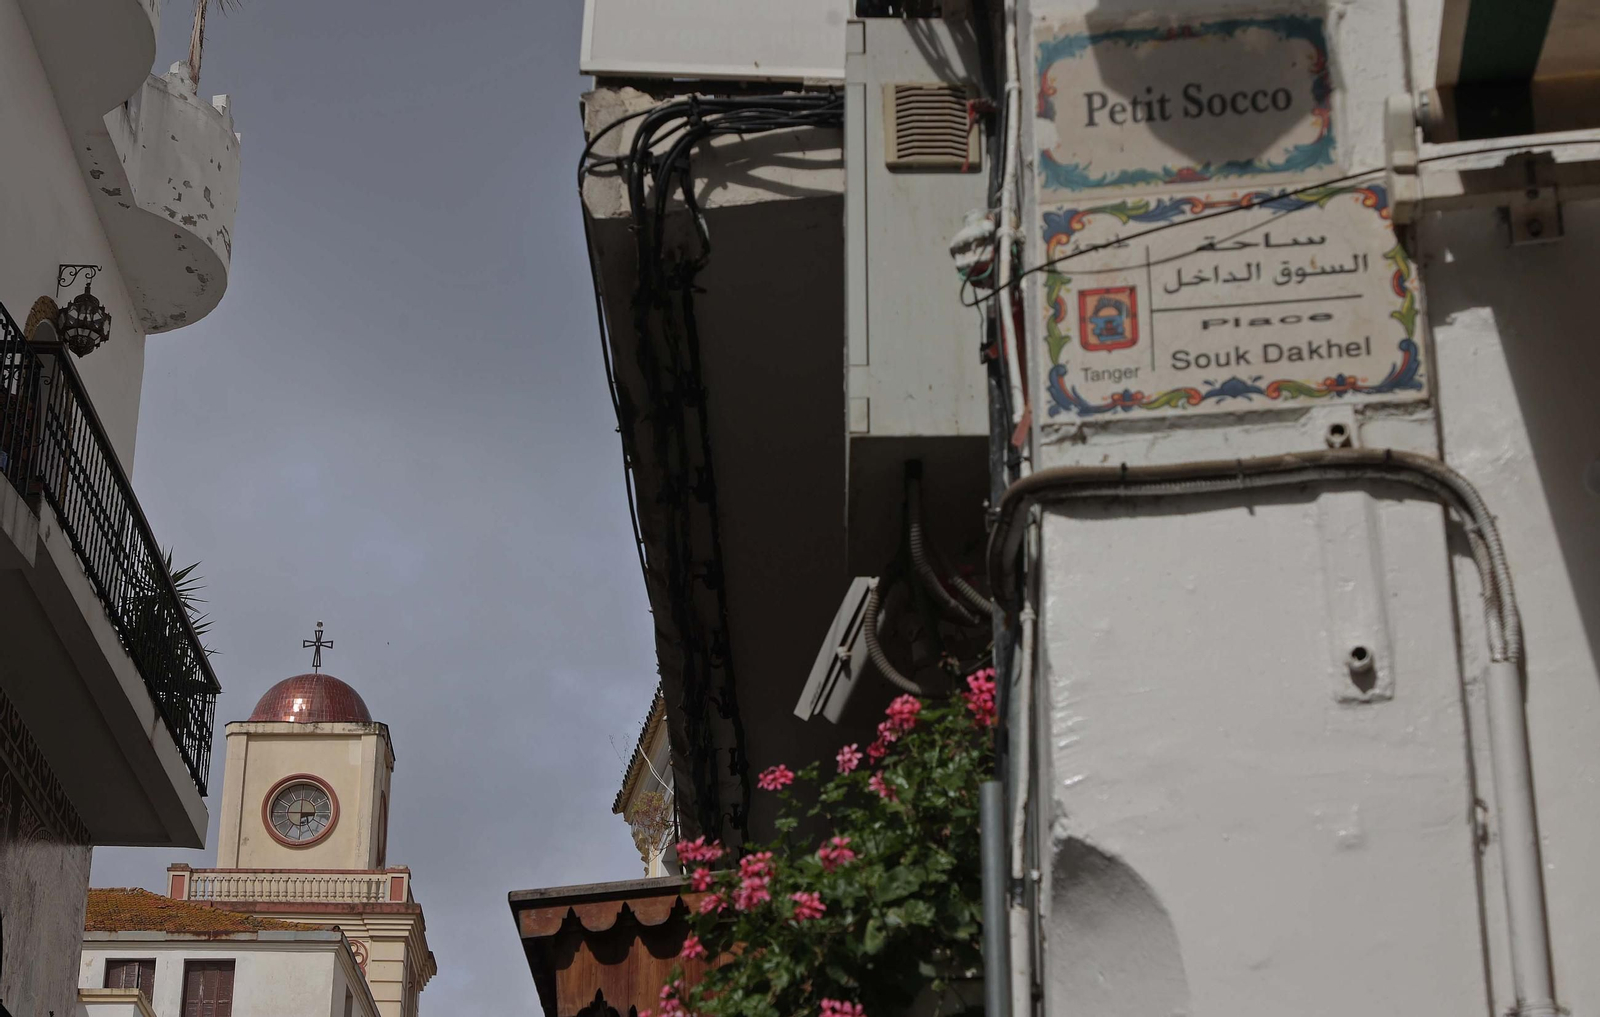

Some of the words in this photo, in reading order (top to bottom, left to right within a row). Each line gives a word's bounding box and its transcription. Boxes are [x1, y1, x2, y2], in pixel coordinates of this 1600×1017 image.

[1084, 86, 1172, 127] Petit
[1183, 83, 1292, 119] Socco
[1199, 232, 1327, 252] ساحة
[1163, 261, 1261, 294] الداخل
[1273, 253, 1368, 286] السوق
[1201, 312, 1334, 330] Place
[1171, 345, 1250, 371] Souk
[1263, 336, 1372, 365] Dakhel
[1080, 366, 1141, 384] Tanger
